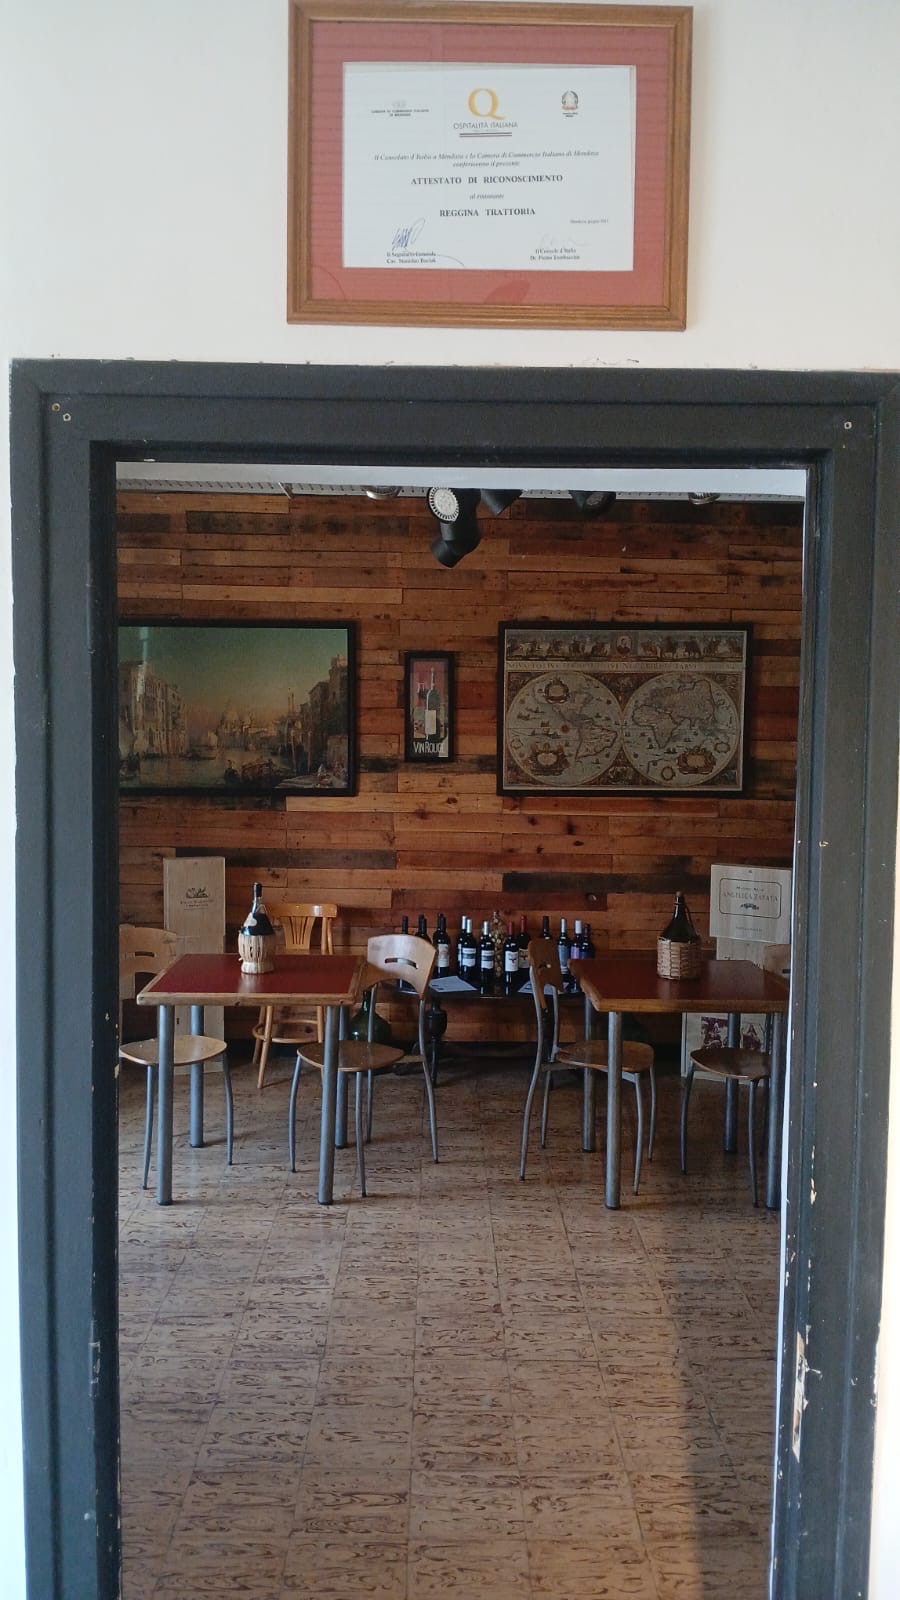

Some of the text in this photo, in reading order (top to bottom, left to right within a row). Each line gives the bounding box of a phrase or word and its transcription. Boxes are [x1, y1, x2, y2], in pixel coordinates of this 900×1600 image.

[490, 121, 519, 129] ITALIANA
[411, 174, 563, 185] ATTESTATO DI RICONOSCIMENTO
[439, 208, 536, 217] REGGINA TRATTORIA
[413, 741, 425, 753] VIN
